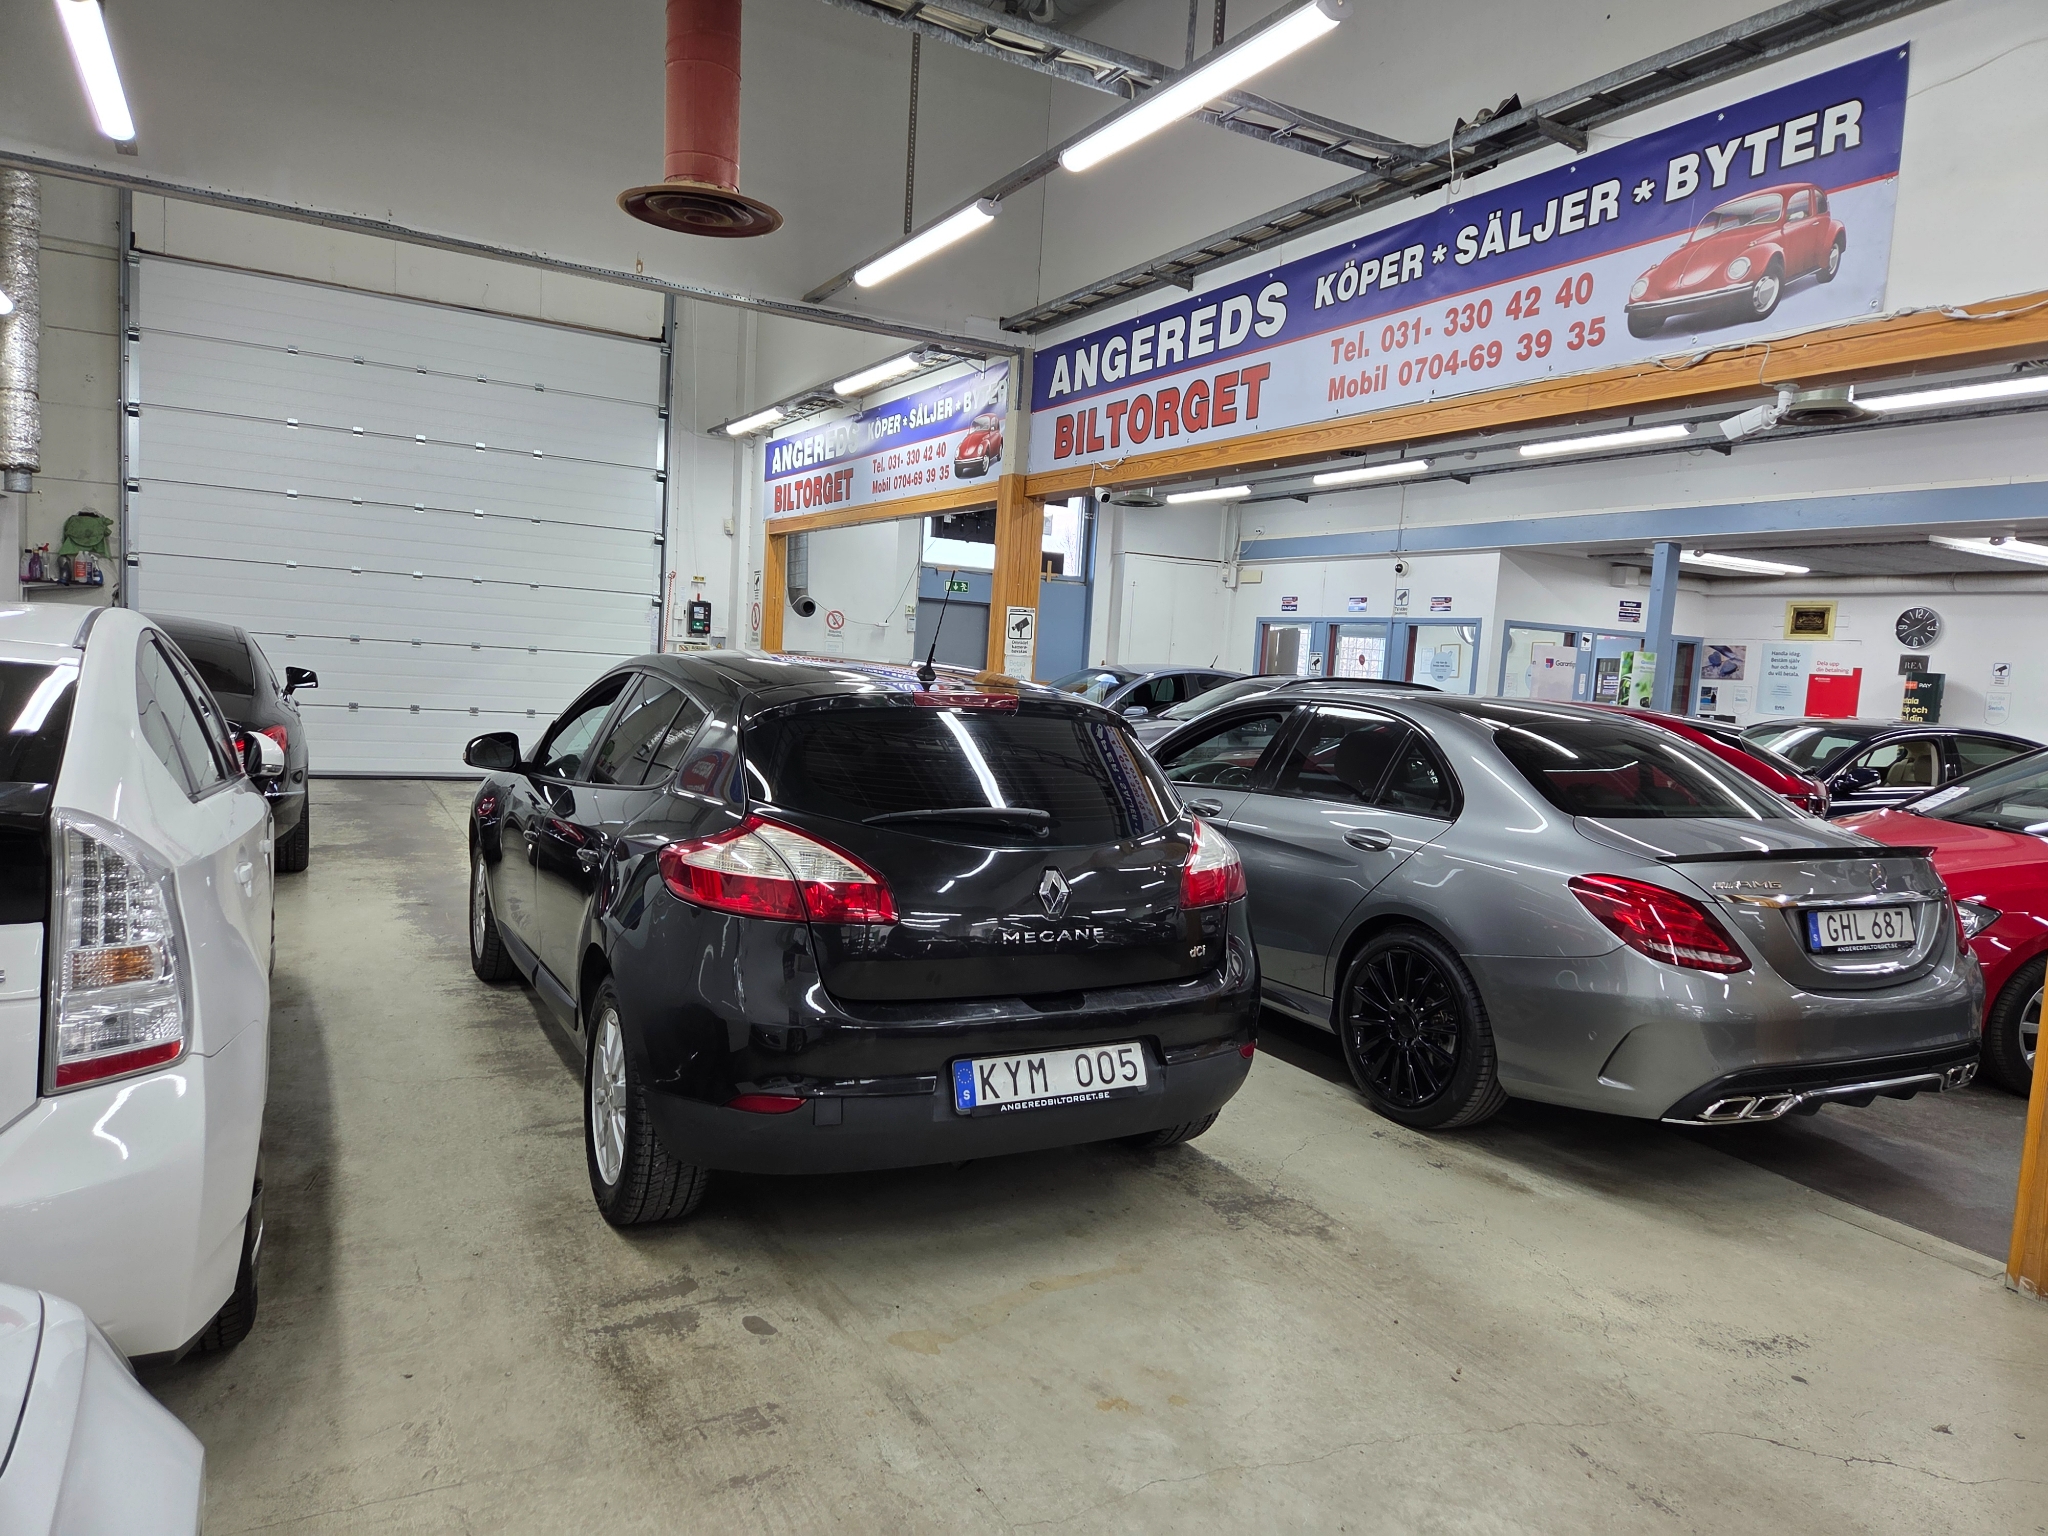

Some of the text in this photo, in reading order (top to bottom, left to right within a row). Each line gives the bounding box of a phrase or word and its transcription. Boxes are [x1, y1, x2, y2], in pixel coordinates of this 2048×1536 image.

[1314, 99, 1864, 310] KÖPER SÄLJER BYTER
[1048, 281, 1289, 400] ANGEREDS
[1330, 272, 1594, 366] Tel. 031- 330 42 40
[1327, 315, 1606, 402] Mobil 0704-69 39 35
[867, 377, 1008, 443] KÖPER SÄLJER BYER
[1054, 362, 1271, 460] BILTORGET
[771, 421, 861, 475] ANGEREDS
[872, 441, 947, 475] Tel. 031- 330 42 40
[774, 467, 854, 514] BILTORGET
[871, 464, 950, 494] Mobil 0704-69 39 35
[1915, 609, 1924, 619] 12
[1911, 705, 1928, 714] och
[1826, 913, 1866, 942] GHL
[1871, 910, 1904, 940] 687
[963, 1047, 1139, 1101] S KYM 005
